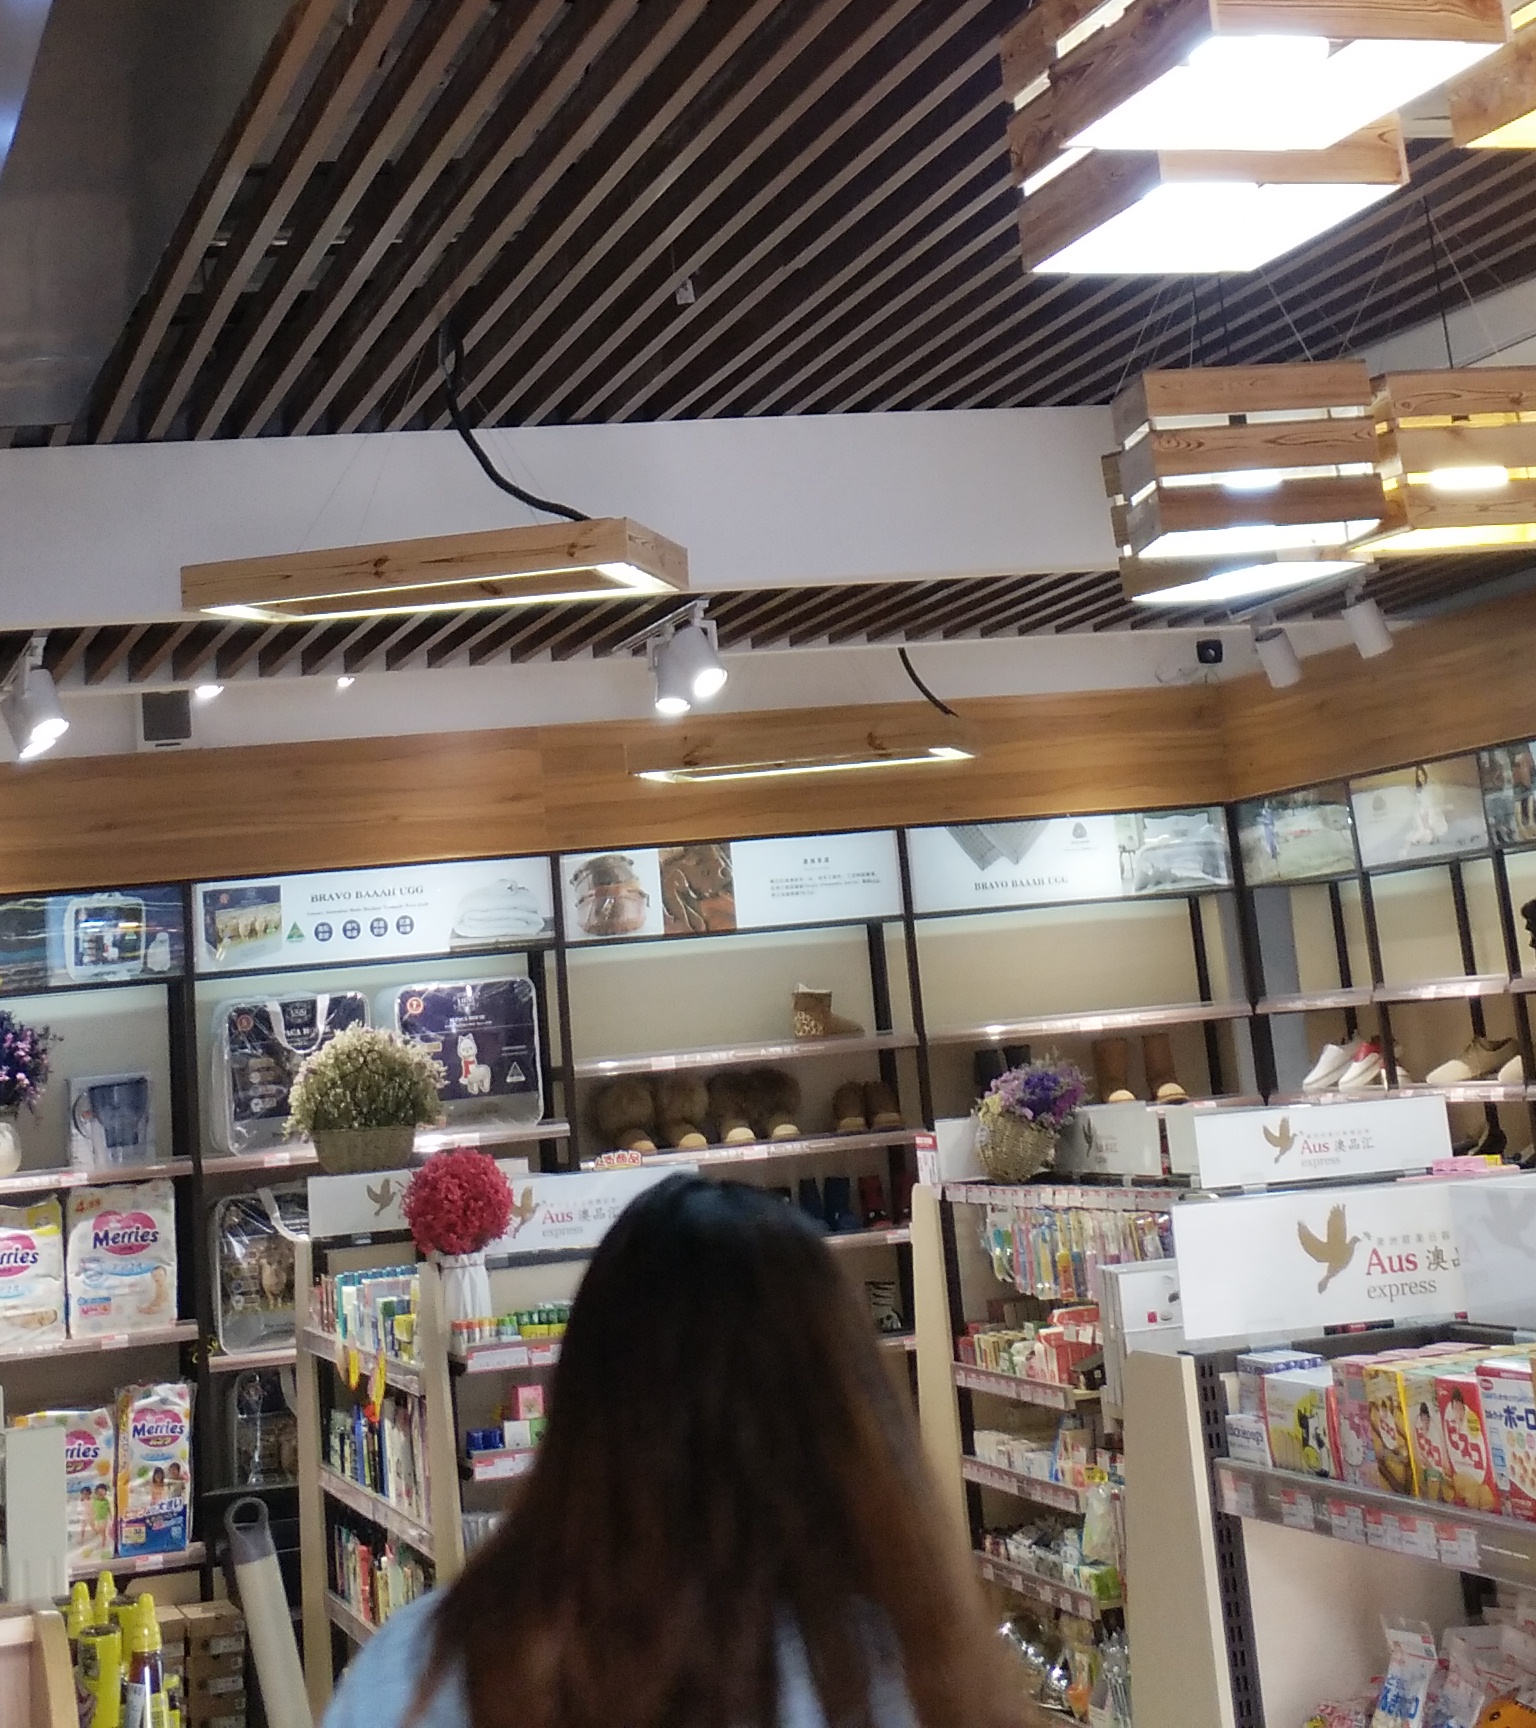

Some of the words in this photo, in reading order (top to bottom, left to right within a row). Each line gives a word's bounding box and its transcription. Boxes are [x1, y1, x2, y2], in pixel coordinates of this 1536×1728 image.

[311, 891, 352, 903] BRAVO
[355, 887, 396, 899] BAAAH
[399, 884, 424, 896] UGG
[974, 880, 1008, 891] BRAVO
[1301, 1138, 1330, 1155] Aus
[1334, 1136, 1375, 1153] 澳品汇
[1301, 1156, 1341, 1169] express
[542, 1208, 574, 1225] Aus
[93, 1225, 161, 1250] Merries
[1365, 1246, 1419, 1277] Aus
[1366, 1279, 1437, 1304] express
[132, 1421, 185, 1439] Merries
[65, 1443, 100, 1459] rries
